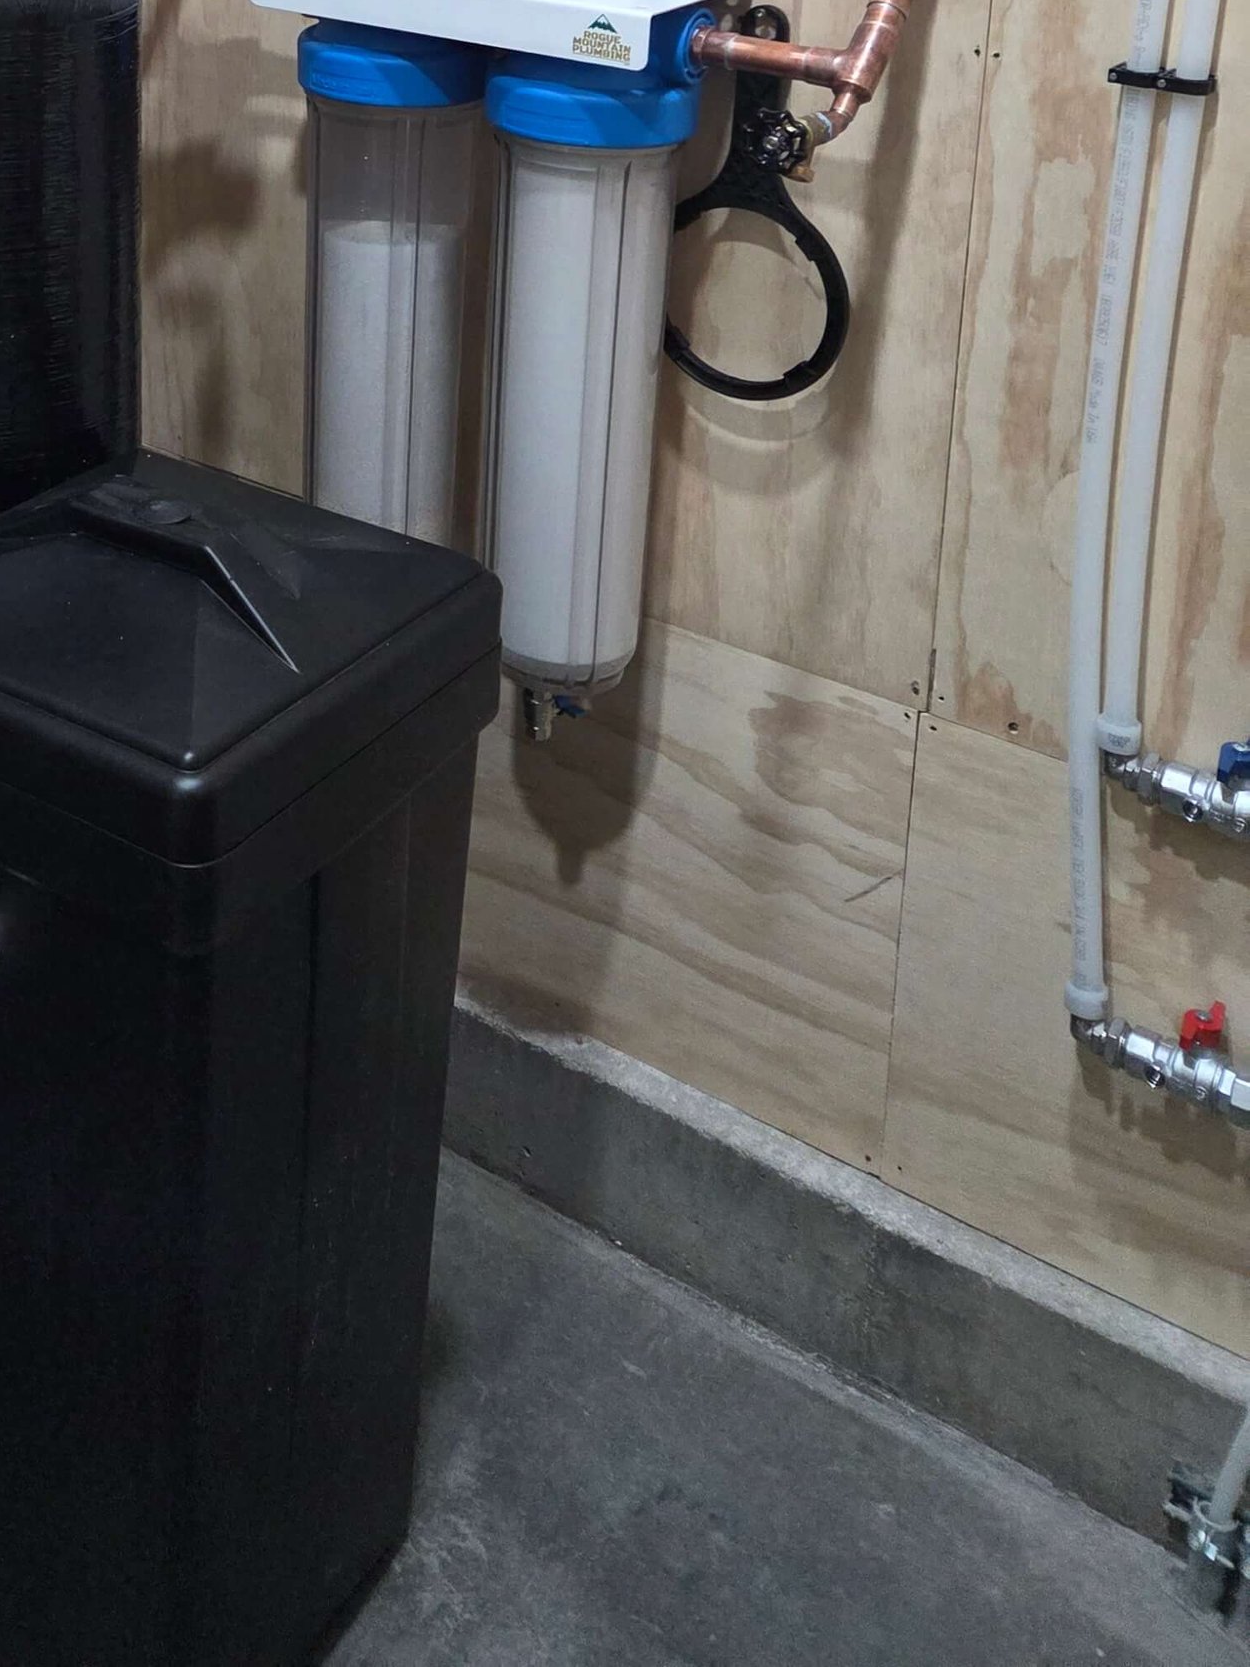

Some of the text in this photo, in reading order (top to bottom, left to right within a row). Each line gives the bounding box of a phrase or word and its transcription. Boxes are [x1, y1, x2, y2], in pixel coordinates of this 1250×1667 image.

[572, 36, 631, 52] MOUNTAIN
[583, 30, 622, 44] ROGUE
[572, 44, 631, 61] PLUMBING
